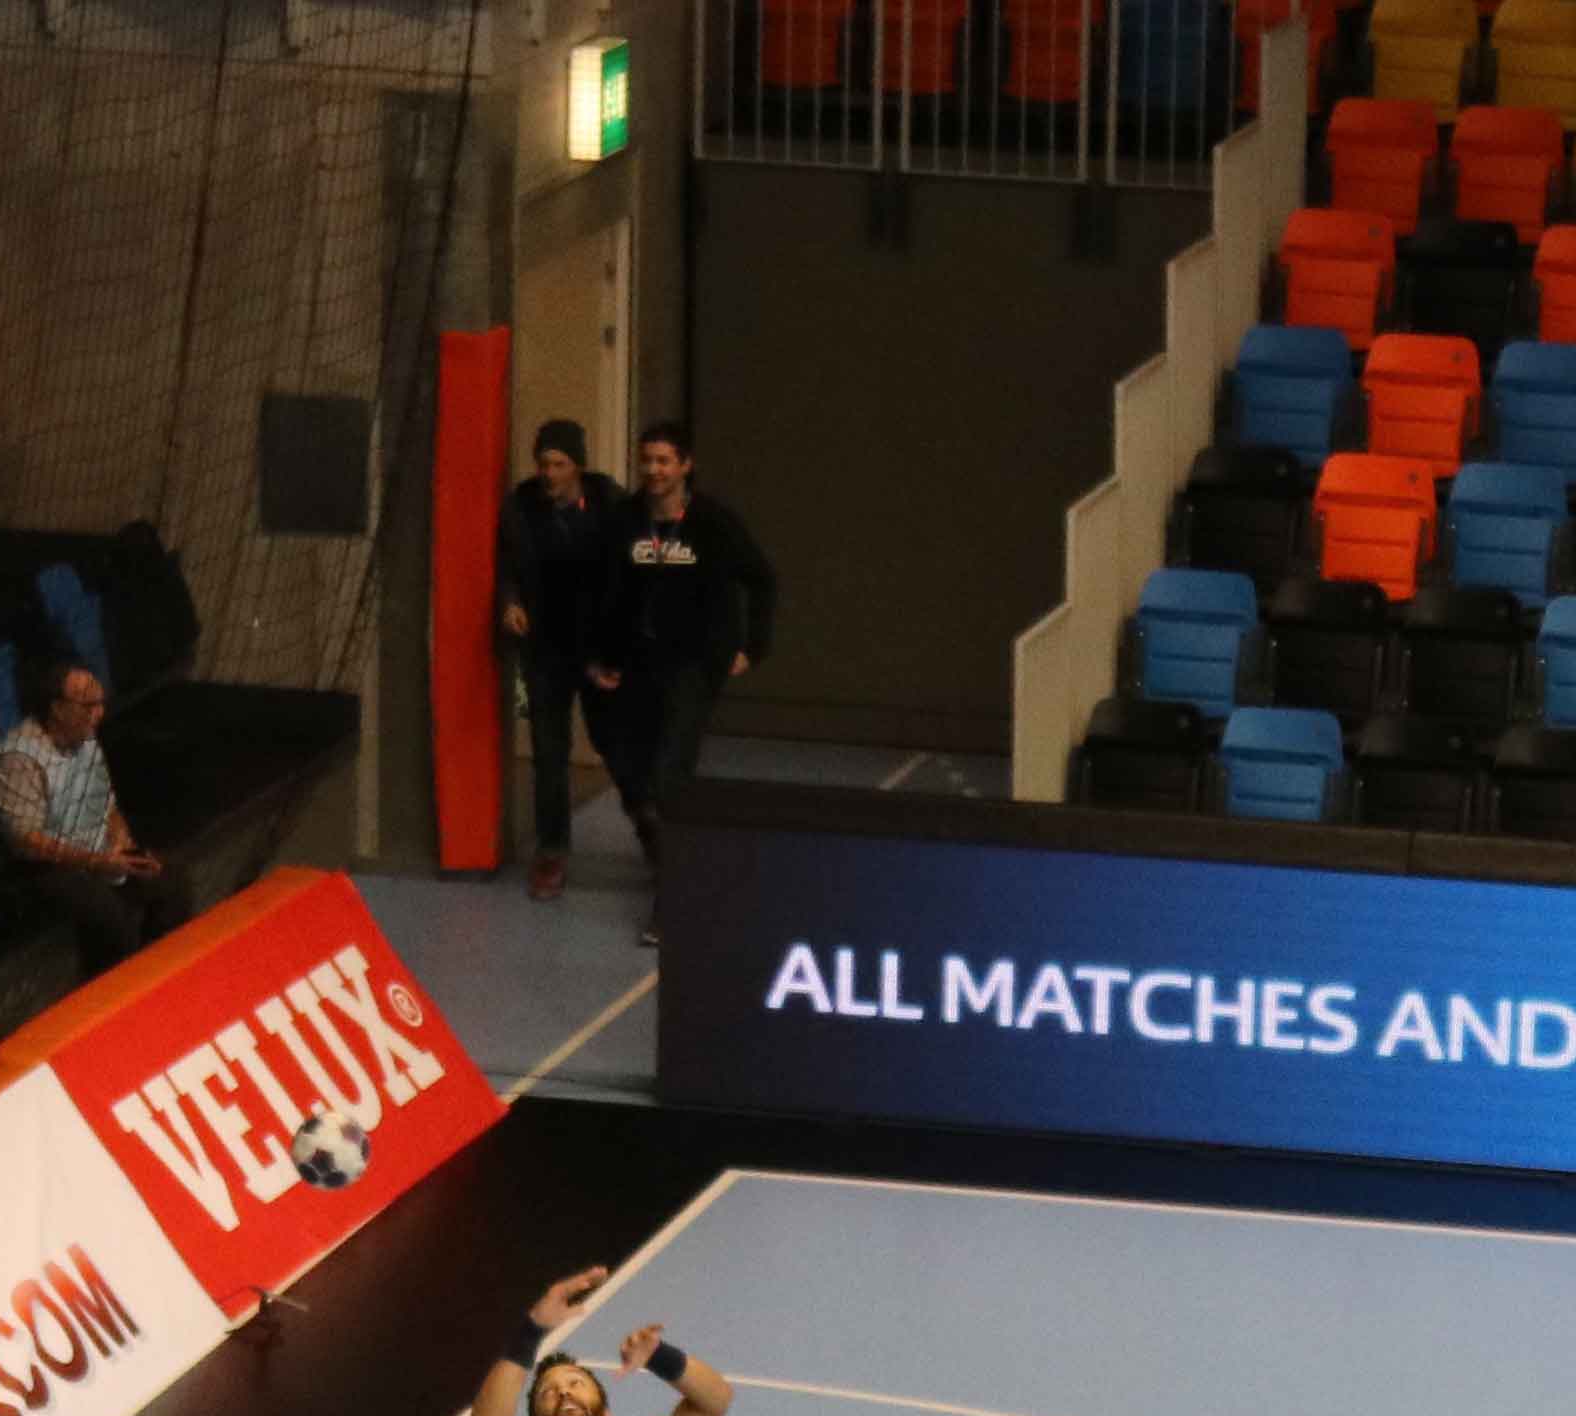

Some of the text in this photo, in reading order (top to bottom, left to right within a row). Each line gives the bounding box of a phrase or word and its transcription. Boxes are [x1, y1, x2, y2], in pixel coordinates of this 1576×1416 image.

[111, 943, 447, 1232] VELUX
[768, 945, 923, 1020] ALL
[943, 957, 1358, 1053] MATCHES
